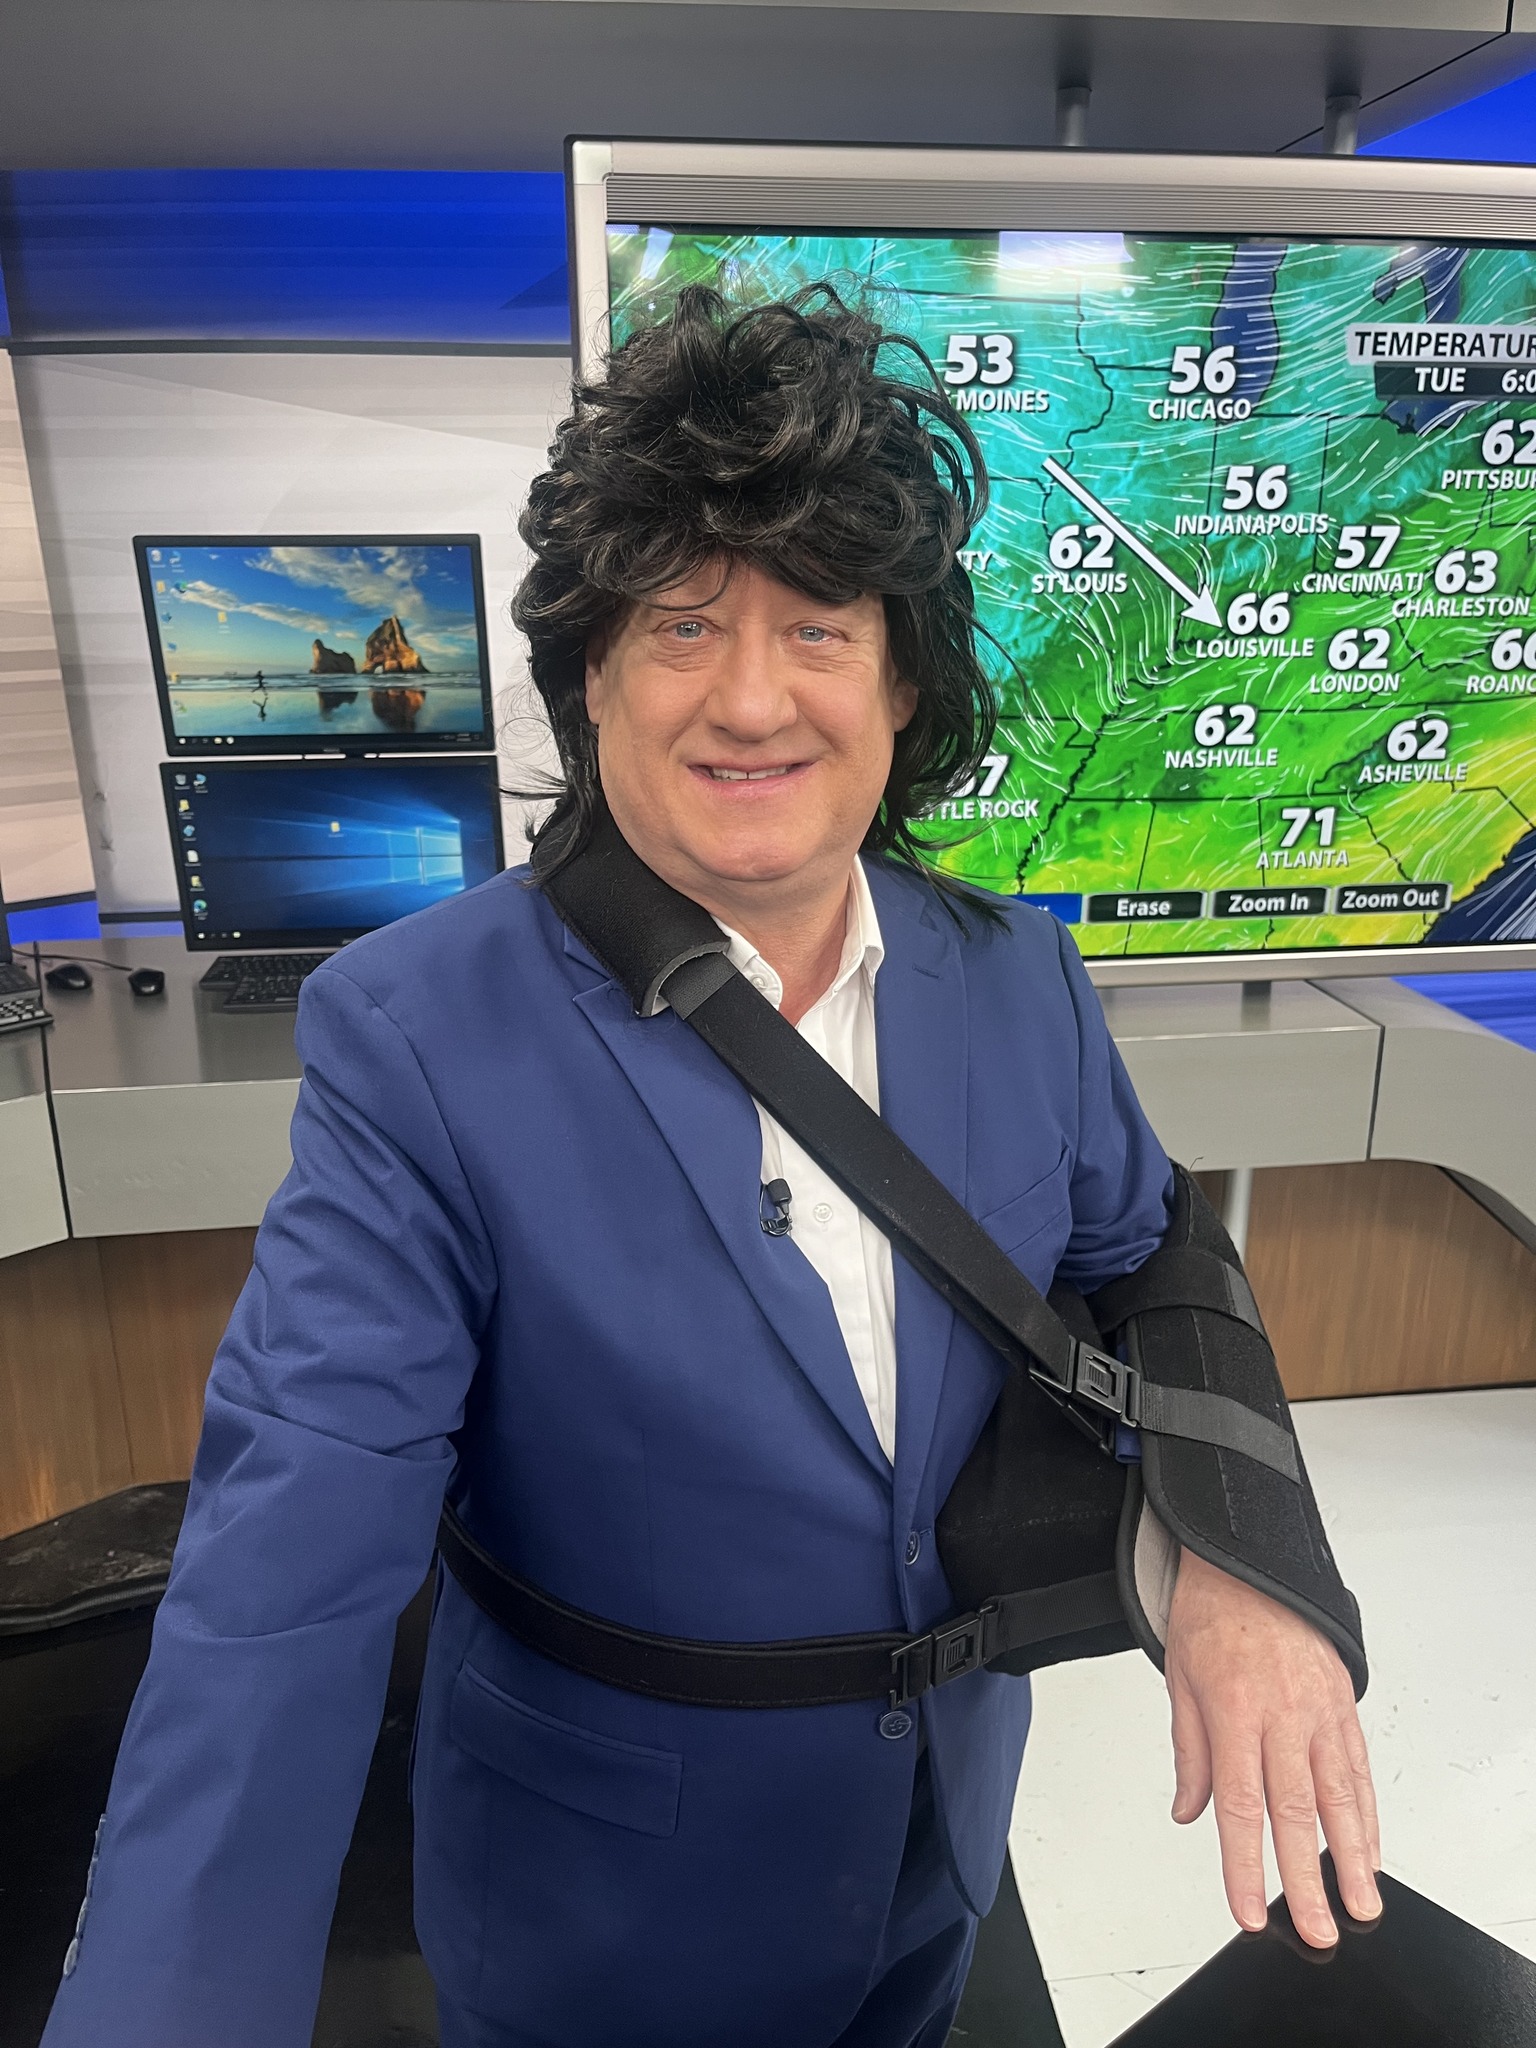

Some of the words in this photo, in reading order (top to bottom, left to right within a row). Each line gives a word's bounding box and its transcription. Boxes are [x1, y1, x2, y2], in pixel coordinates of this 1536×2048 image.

[1355, 331, 1536, 358] TEMPERATUR
[944, 335, 1013, 385] 53
[1168, 345, 1237, 394] 56
[1415, 367, 1466, 392] TUE
[956, 389, 1049, 412] MOINES
[1148, 399, 1251, 420] CHICAGO
[1482, 418, 1536, 465] 62
[1222, 465, 1288, 510] 56
[1174, 514, 1329, 536] INDIANAPOLIS
[1049, 525, 1116, 569] 62
[1334, 525, 1401, 570] 57
[1302, 572, 1423, 593] CINCINNATI
[1434, 549, 1498, 594] 63
[1031, 573, 1058, 594] ST
[1062, 573, 1127, 594] LOUIS
[1226, 592, 1290, 635] 66
[1392, 597, 1530, 618] CHARLESTON
[1196, 638, 1314, 659] LOUISVILLE
[1328, 628, 1391, 671] 62
[1310, 673, 1400, 694] LONDON
[1194, 704, 1257, 747] 62
[1387, 719, 1449, 762] 62
[1164, 748, 1278, 769] NASHVILLE
[1358, 763, 1468, 783] ASHEVILLE
[980, 799, 1040, 819] ROCK
[1281, 806, 1336, 848] 71
[1256, 850, 1349, 870] ATLANTA
[1117, 898, 1172, 917] Erase
[1228, 894, 1285, 913] Zoom
[1289, 893, 1309, 911] In
[1342, 890, 1399, 910] Zoom
[1403, 889, 1440, 907] Out
